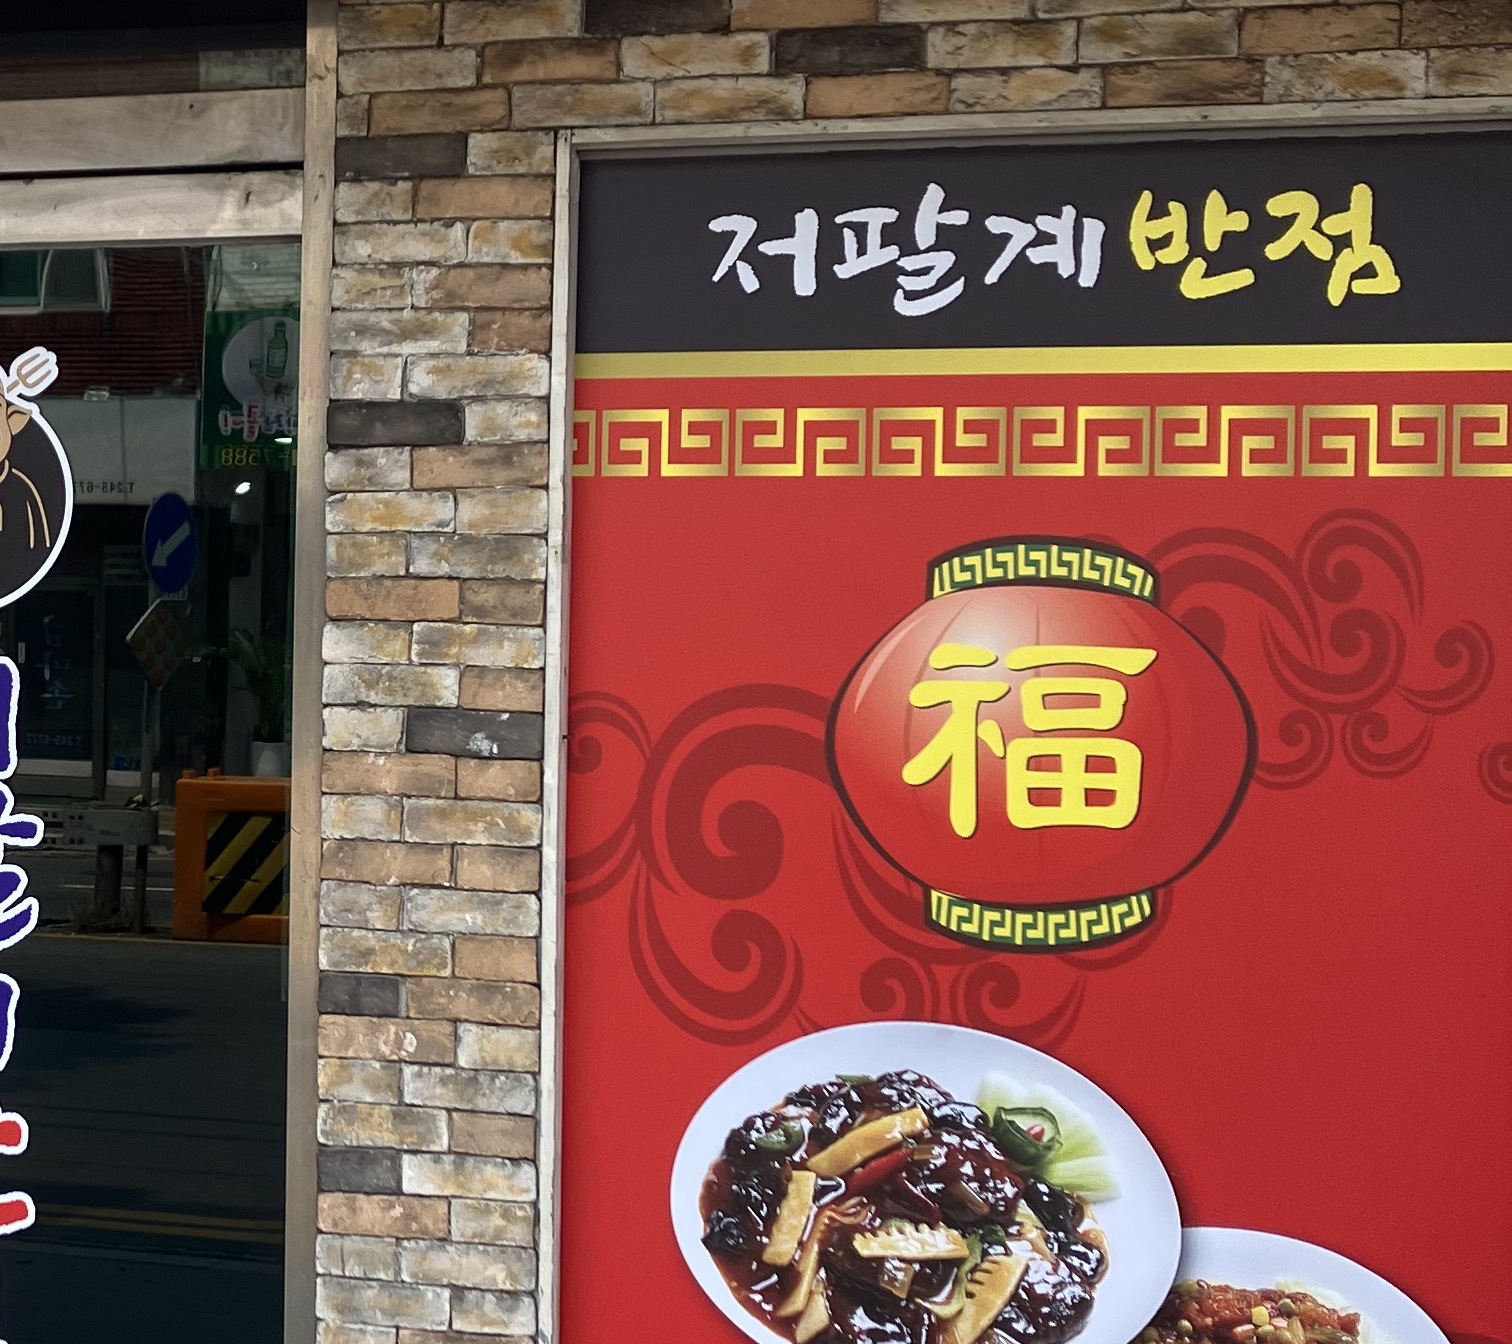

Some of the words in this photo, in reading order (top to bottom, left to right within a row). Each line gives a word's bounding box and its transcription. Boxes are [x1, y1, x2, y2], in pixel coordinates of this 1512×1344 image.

[708, 182, 1106, 317] 저팔계
[1129, 183, 1401, 307] 반점
[902, 642, 1157, 839] 福
